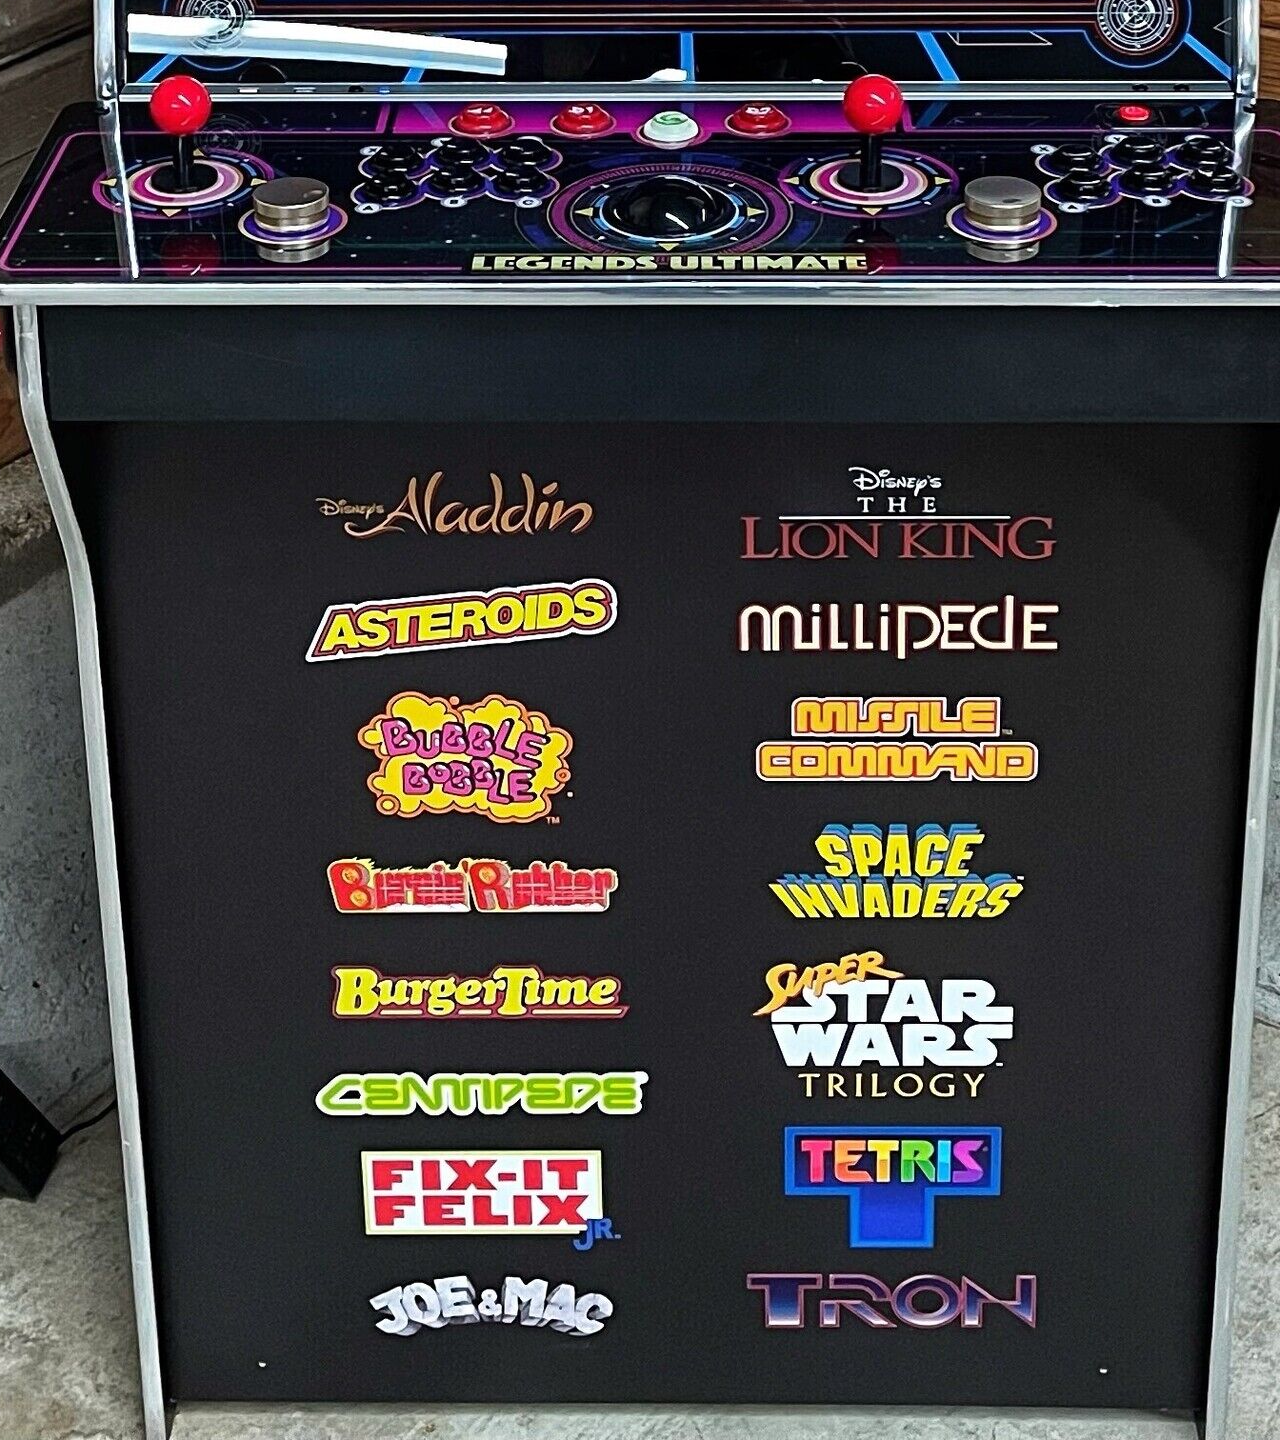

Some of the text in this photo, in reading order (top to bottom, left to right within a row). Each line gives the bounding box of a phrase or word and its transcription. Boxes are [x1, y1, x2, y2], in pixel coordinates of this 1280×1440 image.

[472, 255, 657, 271] LEGENDS
[671, 254, 867, 270] ULTIMATE
[344, 471, 594, 540] Aladdin
[857, 496, 937, 513] THE
[740, 516, 1057, 560] LION KING
[320, 587, 607, 652] ASTEROIDS
[794, 700, 998, 734] MISSILE
[381, 718, 549, 769] BUBBLE
[760, 744, 1036, 778] COMMAND
[403, 759, 536, 805] BOBBLE
[814, 828, 986, 877] SPACE
[768, 882, 1024, 919] INVADERS
[334, 967, 617, 1016] BurgerTime
[752, 950, 906, 1017] SUPER
[770, 978, 1014, 1023] STAR
[771, 1023, 1014, 1067] WARS
[322, 1077, 637, 1110] CENTIPEDE
[797, 1072, 986, 1098] TRILOGY
[371, 1159, 589, 1191] FIX-IT
[800, 1139, 985, 1183] TETRIS
[373, 1195, 589, 1226] FELIX
[572, 1218, 622, 1252] JR.
[746, 1273, 1037, 1329] TRON
